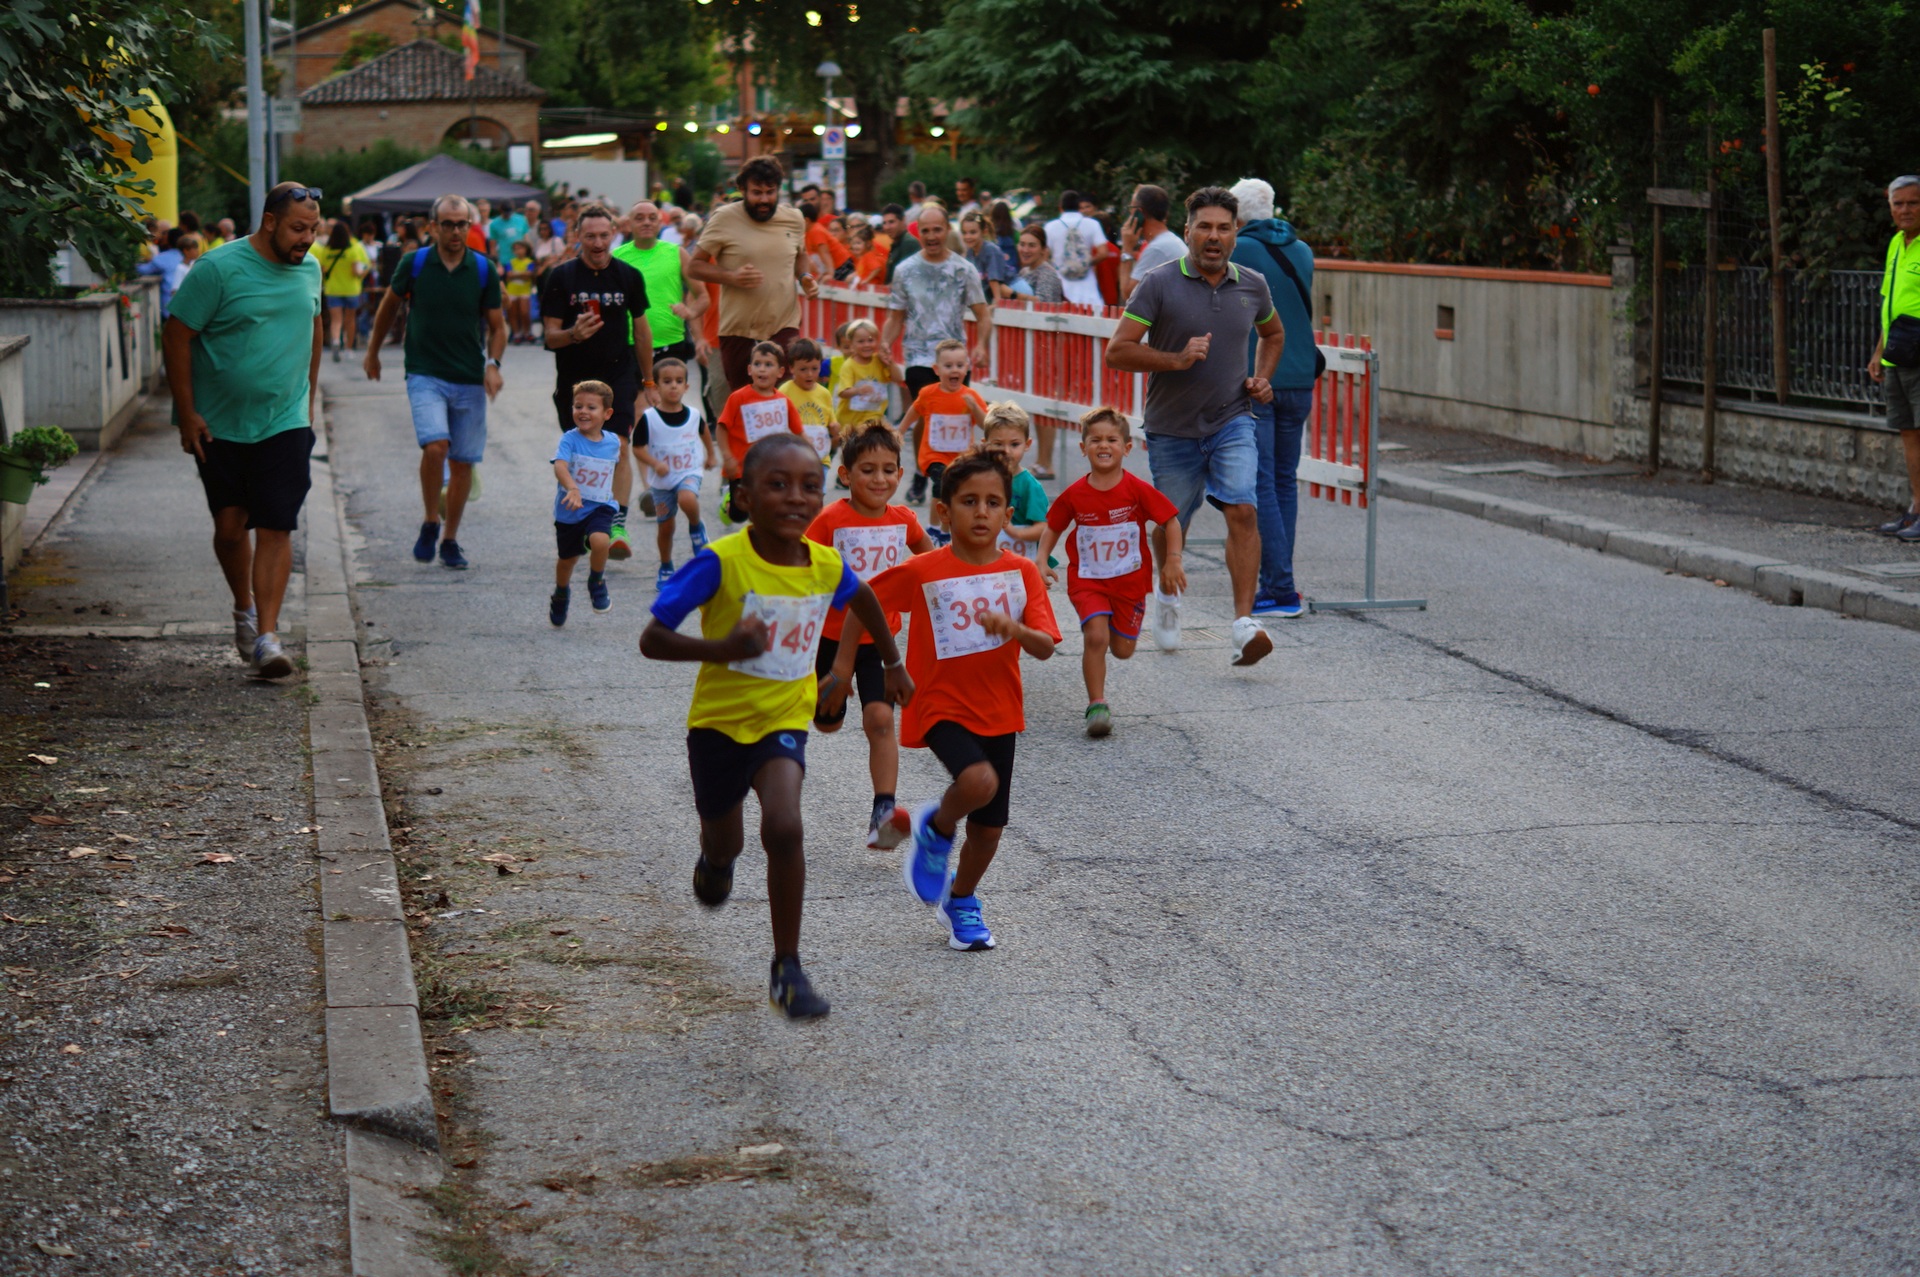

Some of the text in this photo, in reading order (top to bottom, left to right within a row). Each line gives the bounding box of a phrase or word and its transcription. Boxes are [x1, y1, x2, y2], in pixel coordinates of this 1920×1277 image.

[754, 411, 783, 429] 380
[939, 426, 967, 440] 171
[663, 454, 692, 470] 162
[575, 468, 609, 488] 527
[850, 545, 898, 572] 379
[1088, 539, 1129, 562] 179
[949, 592, 1012, 631] 381
[765, 620, 816, 655] 149
